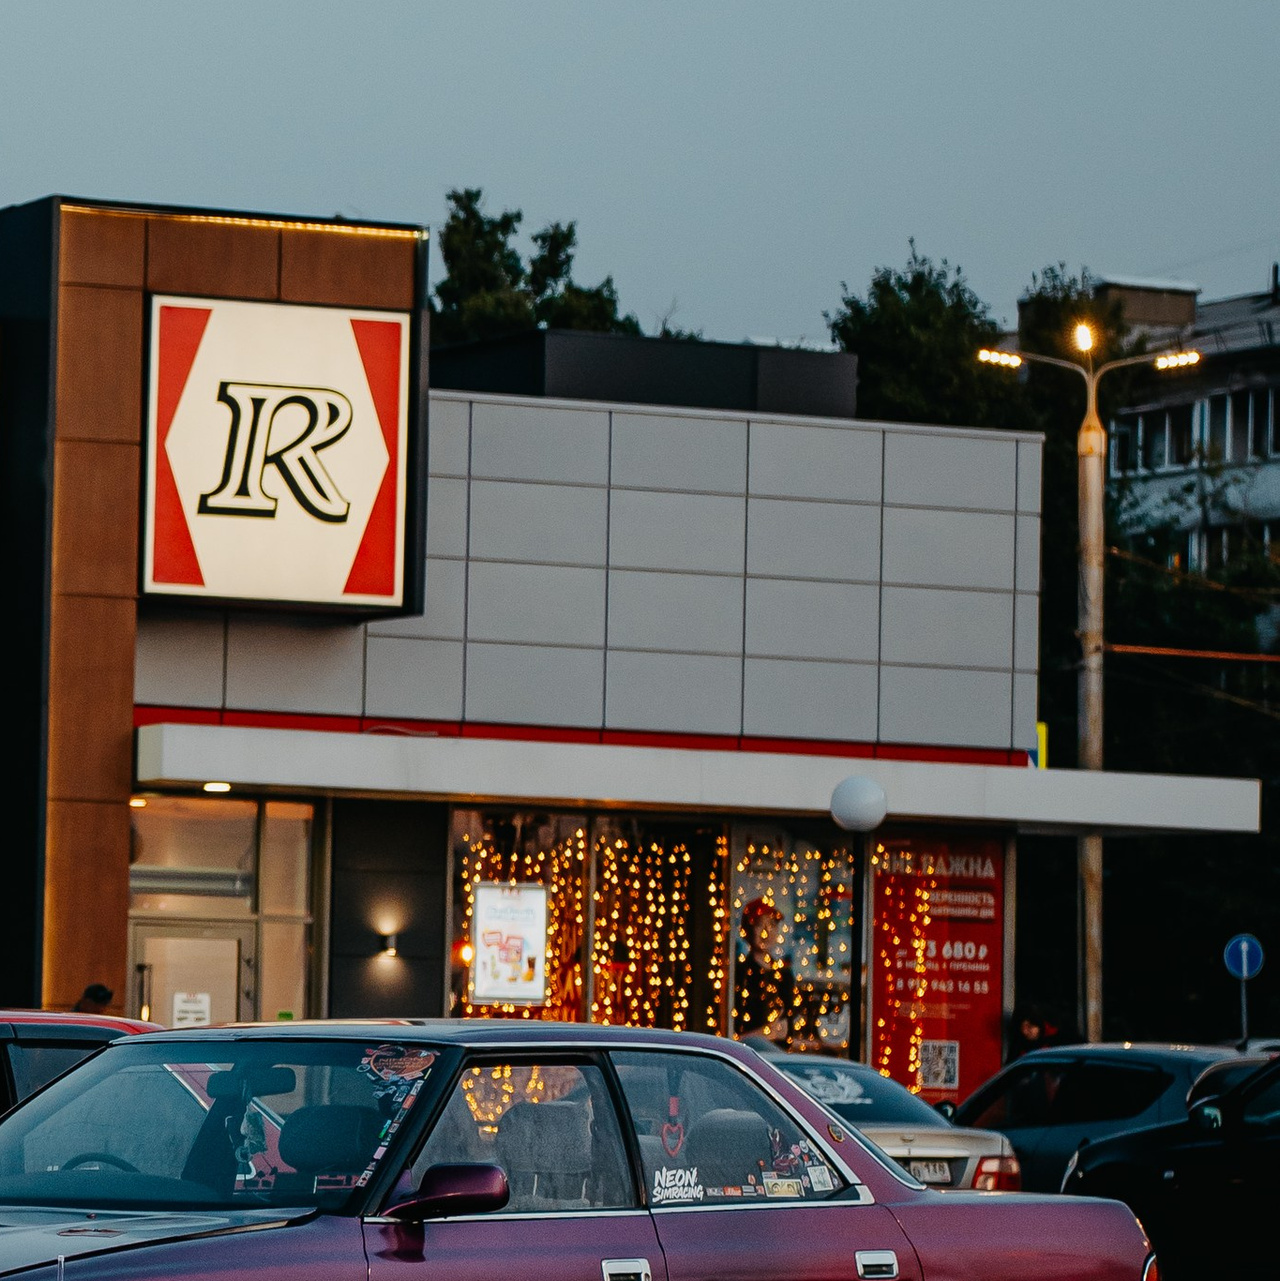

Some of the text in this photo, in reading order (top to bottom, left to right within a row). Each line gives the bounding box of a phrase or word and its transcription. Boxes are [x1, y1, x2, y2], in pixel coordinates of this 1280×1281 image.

[197, 381, 353, 524] R
[654, 1166, 698, 1188] NEON
[652, 1184, 703, 1203] SIMRACING
